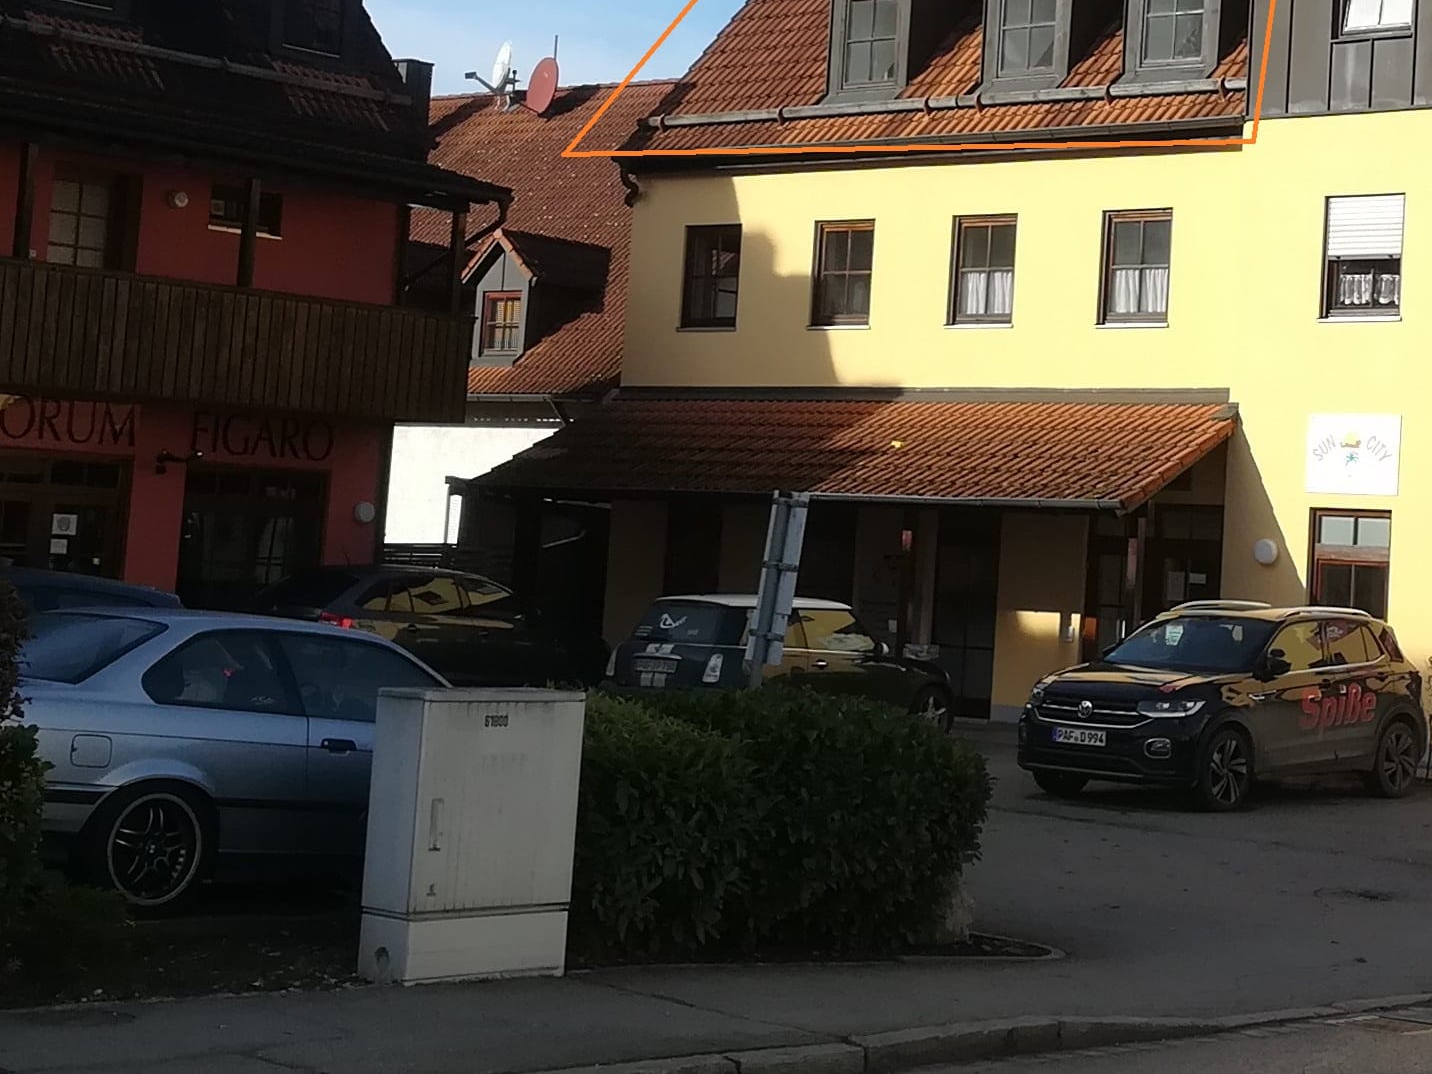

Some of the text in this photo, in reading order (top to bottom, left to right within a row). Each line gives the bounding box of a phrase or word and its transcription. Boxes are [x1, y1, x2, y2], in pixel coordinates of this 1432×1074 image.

[190, 411, 335, 462] FIGARO
[1312, 433, 1392, 462] SUN CITY
[1301, 683, 1377, 733] Spiße
